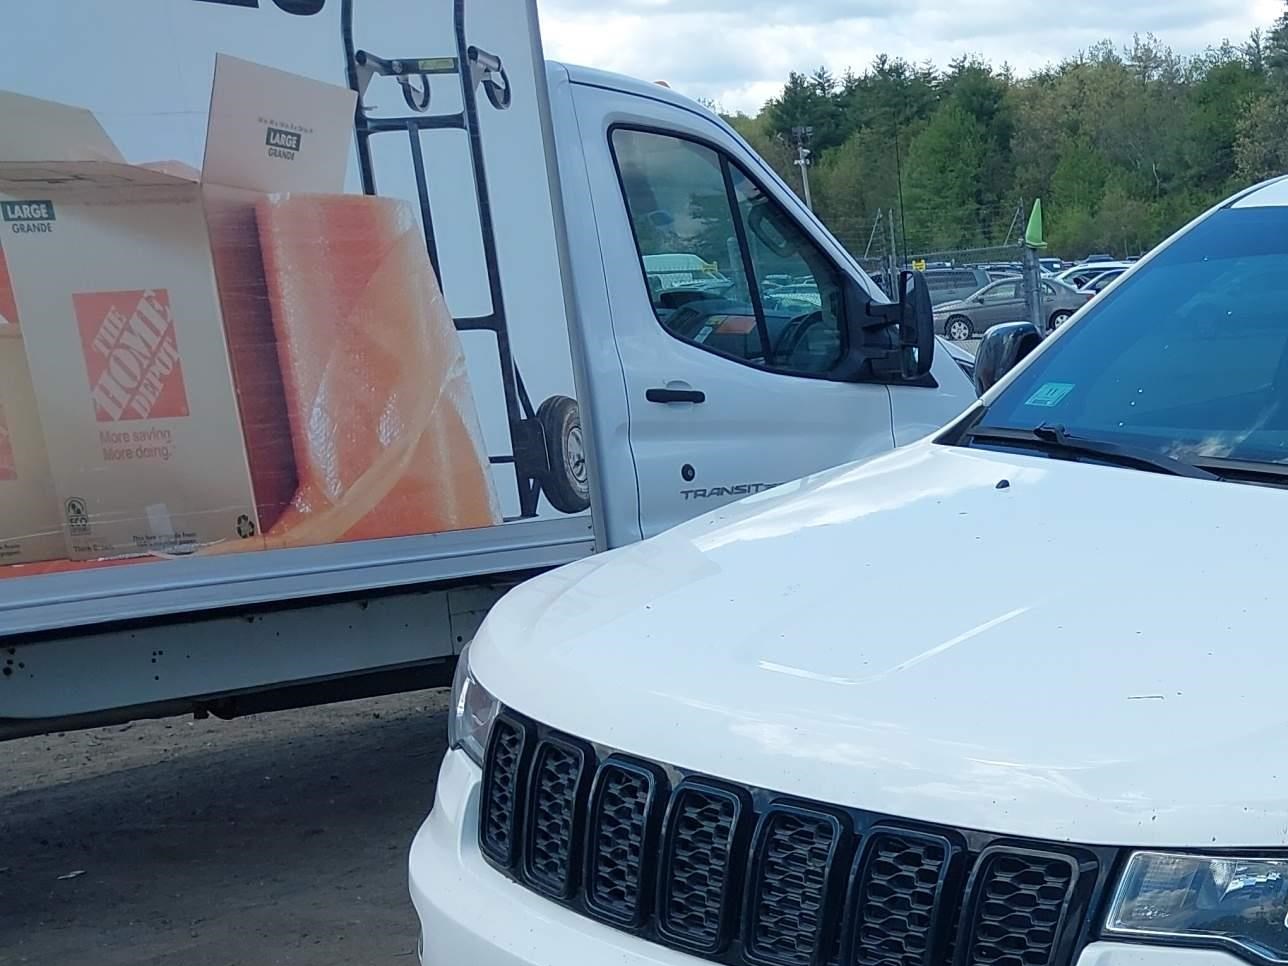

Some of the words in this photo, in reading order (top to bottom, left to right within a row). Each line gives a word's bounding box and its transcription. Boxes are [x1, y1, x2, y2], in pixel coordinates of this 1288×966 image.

[270, 131, 297, 148] LARGE
[7, 204, 49, 219] LARGE
[12, 223, 53, 233] GRANDE
[93, 305, 127, 356] THE
[93, 289, 171, 421] HOME
[131, 336, 181, 420] DEPOT
[99, 431, 130, 443] More
[102, 447, 132, 461] More
[680, 483, 764, 500] TRANSIT
